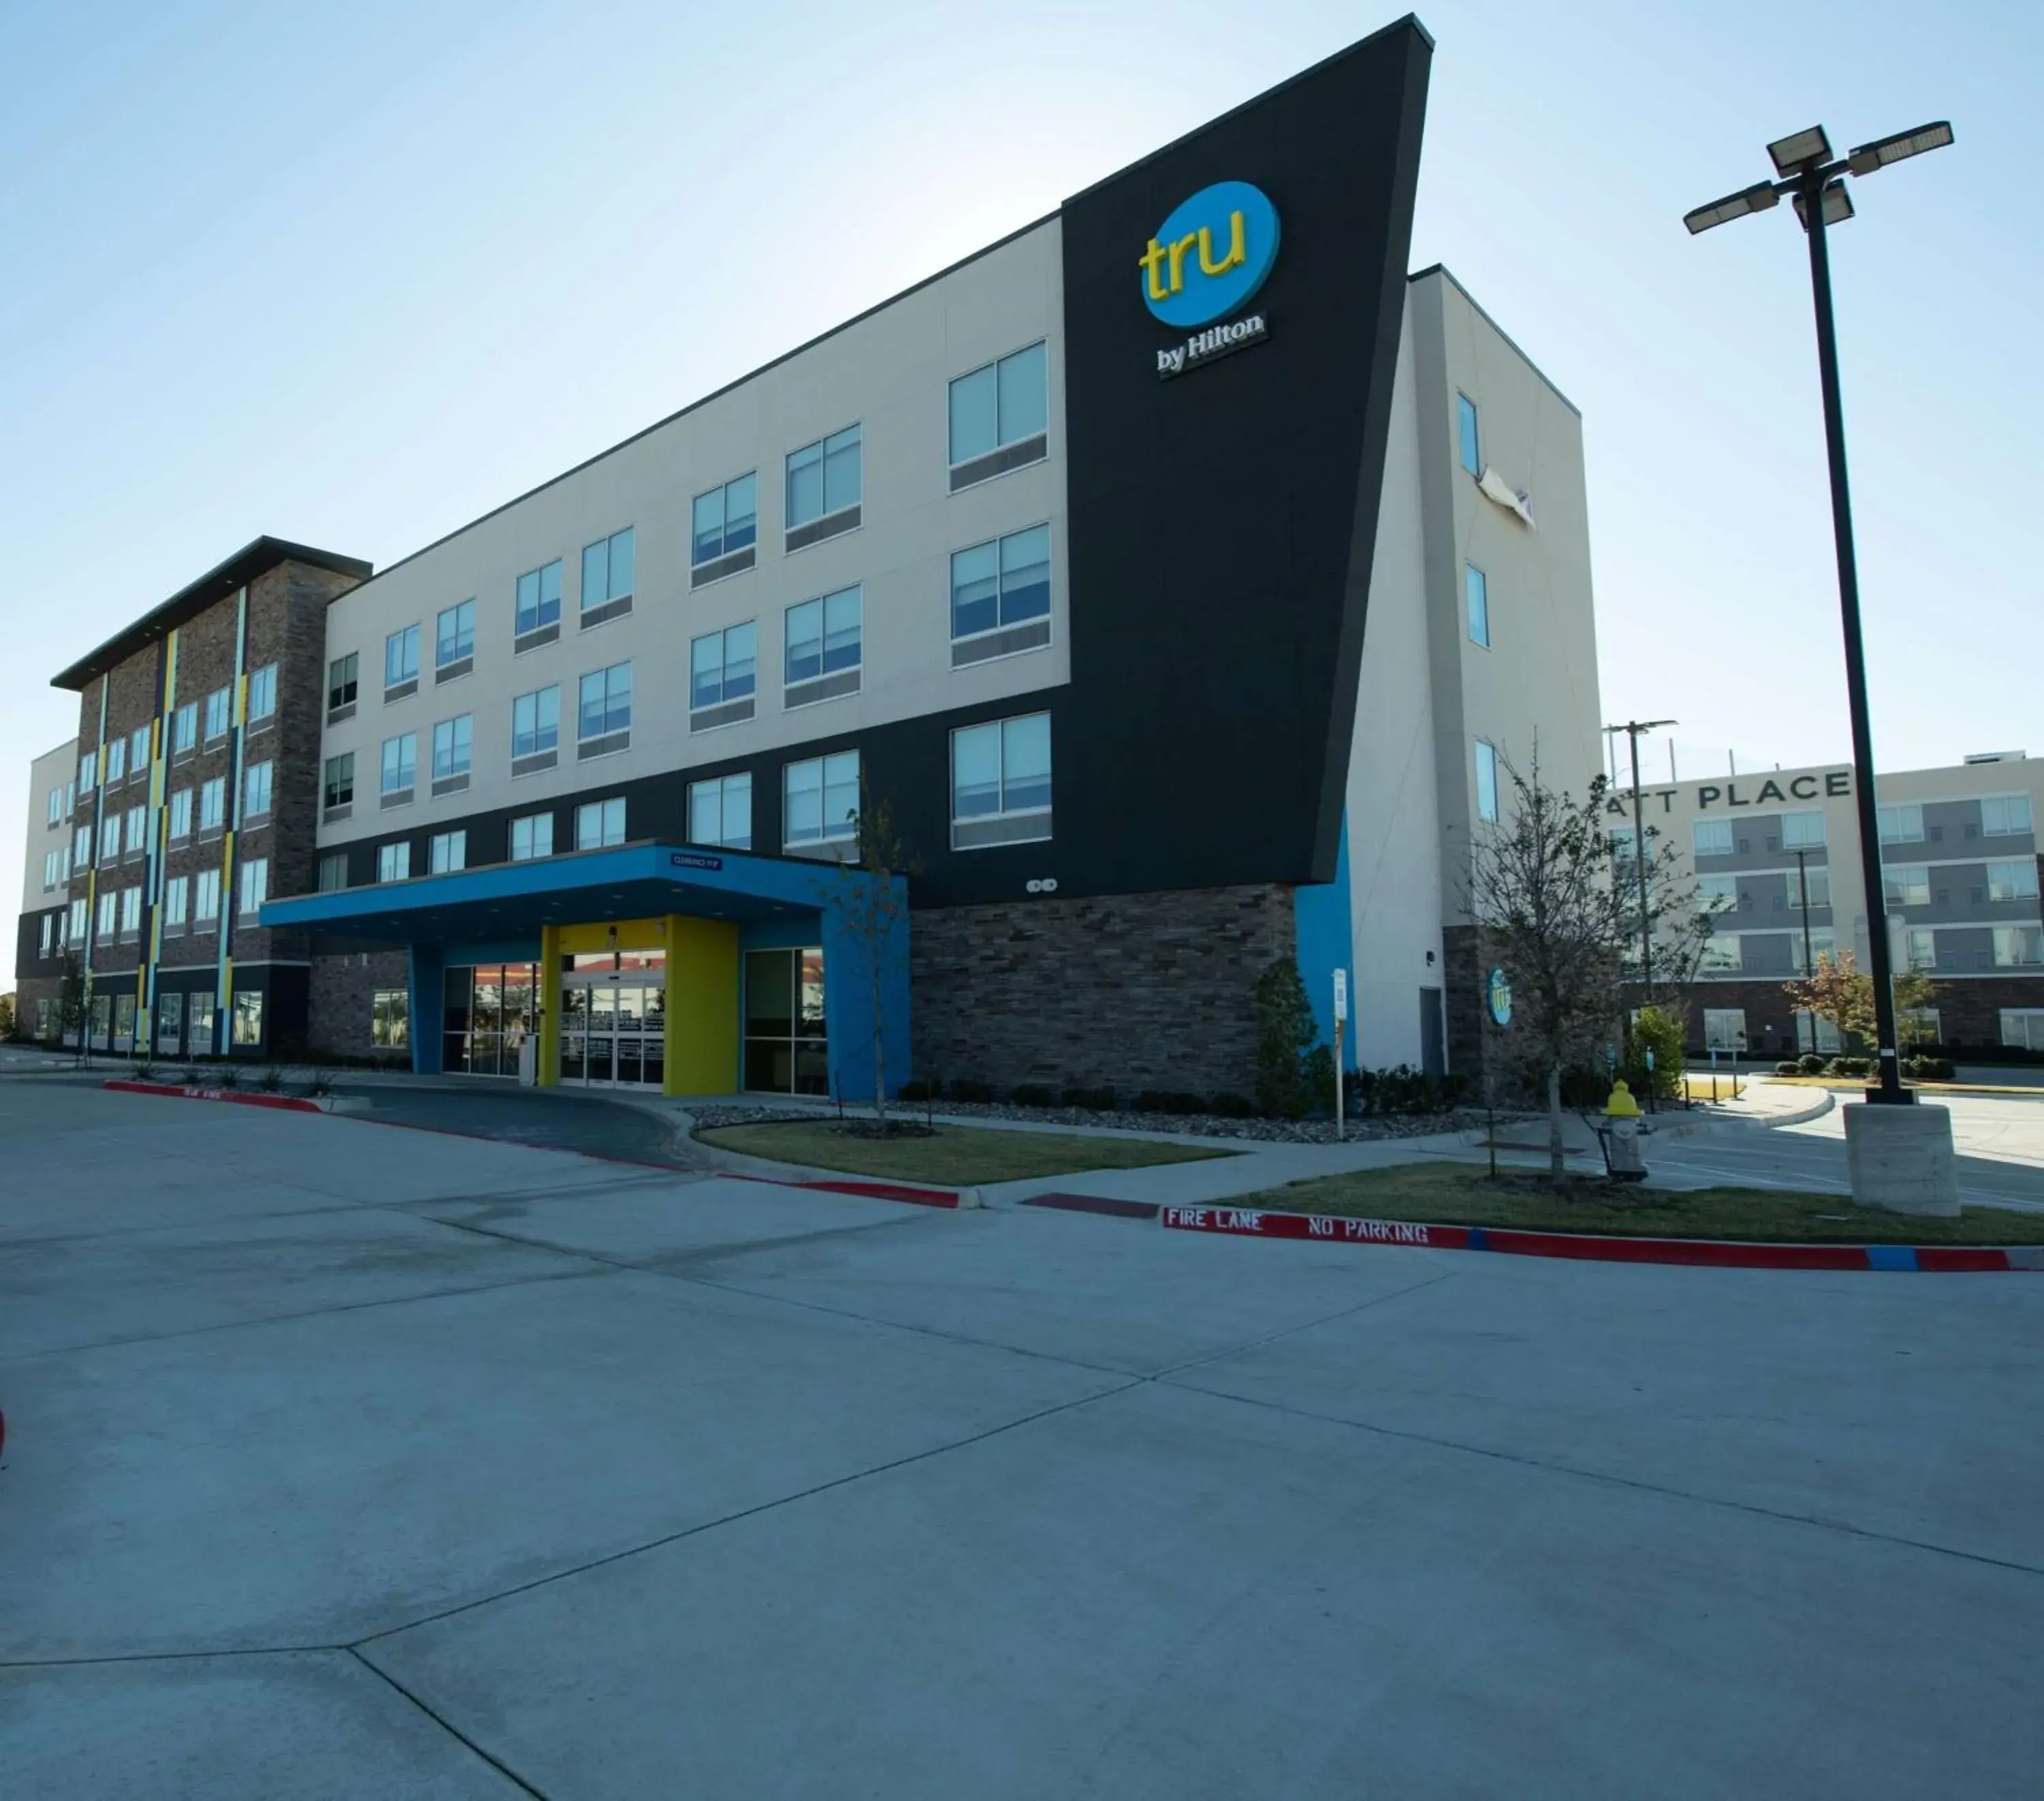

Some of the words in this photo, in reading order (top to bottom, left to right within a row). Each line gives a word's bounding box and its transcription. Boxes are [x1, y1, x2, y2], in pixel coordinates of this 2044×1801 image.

[1139, 210, 1245, 301] tru
[1157, 345, 1187, 373] by
[1188, 315, 1266, 359] Hilton
[1698, 771, 1851, 810] PLACE
[1168, 1208, 1207, 1227] FIRE
[1215, 1210, 1263, 1231] LANE
[1308, 1217, 1333, 1235] NO
[1345, 1219, 1429, 1243] PARKING
